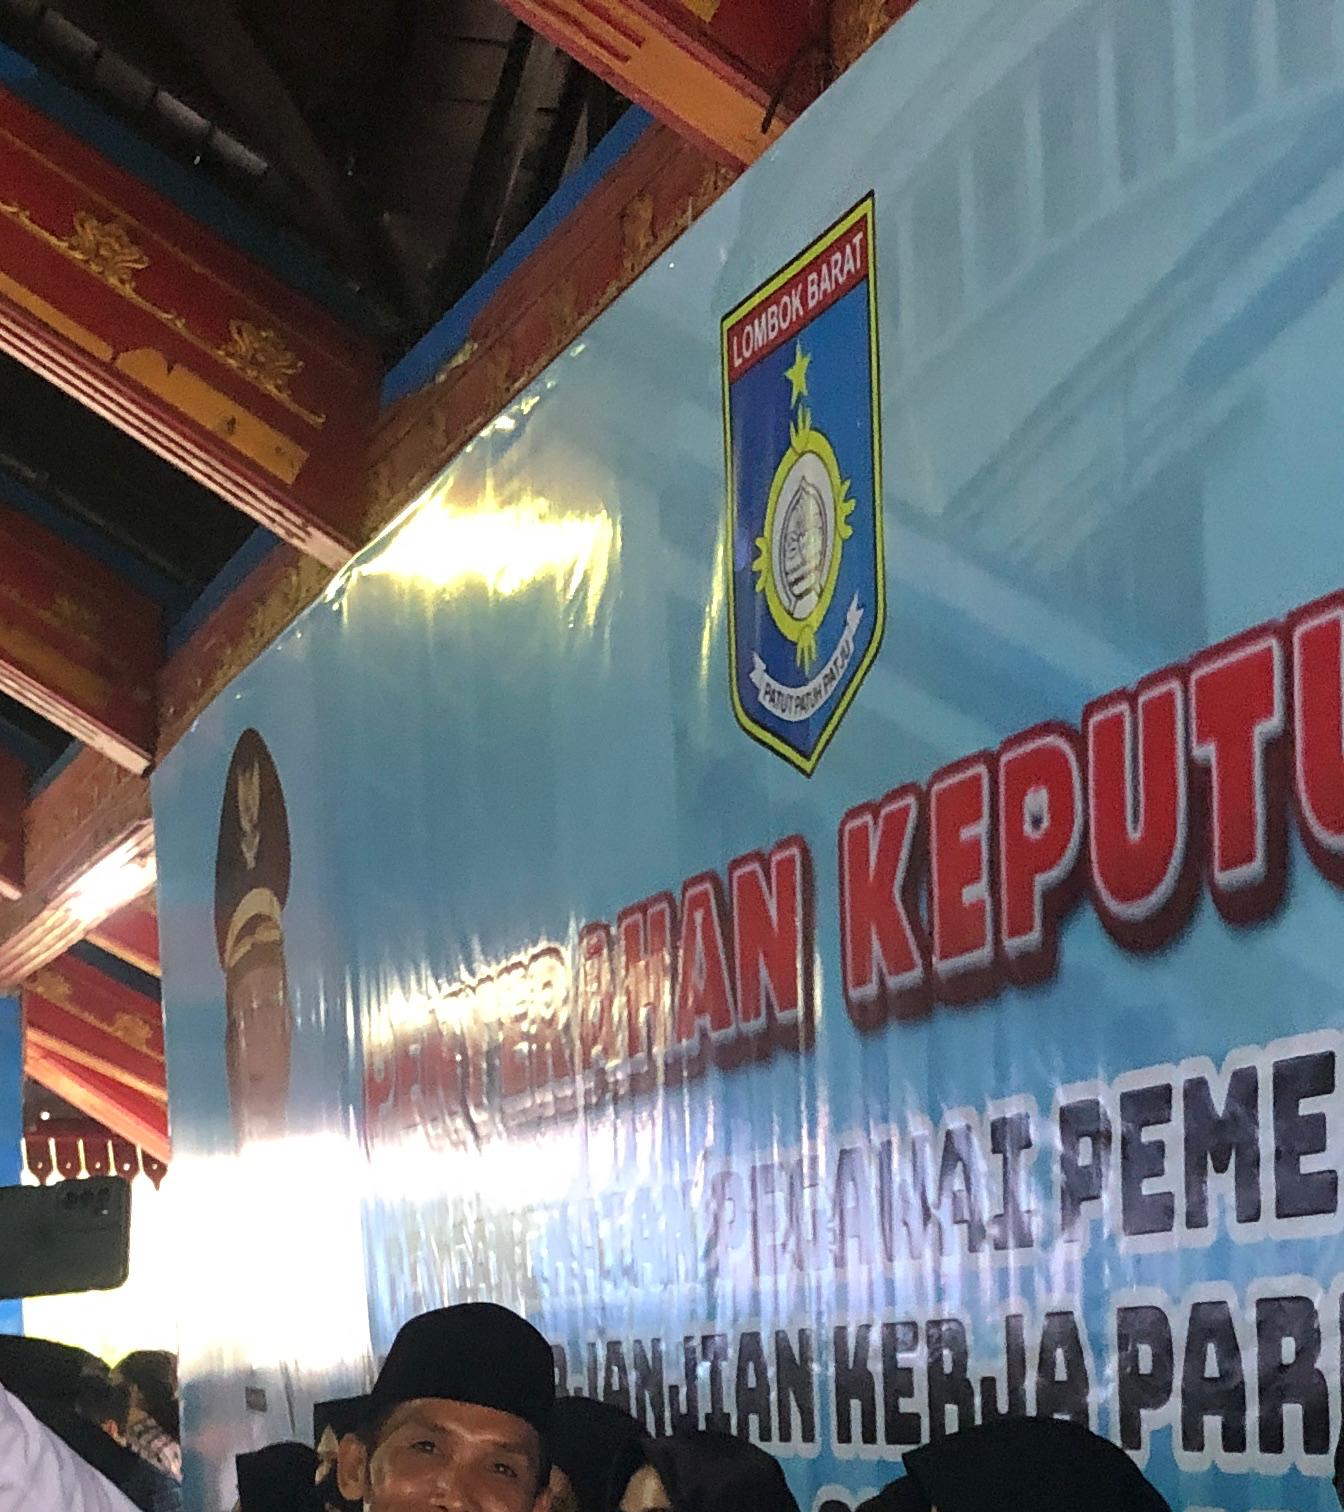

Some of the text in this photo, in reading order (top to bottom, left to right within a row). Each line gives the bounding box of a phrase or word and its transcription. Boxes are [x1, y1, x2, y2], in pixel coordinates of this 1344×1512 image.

[733, 231, 864, 368] LOMBOK BARAT
[551, 1327, 817, 1445] JANJIAN
[833, 1310, 1090, 1446] KERJA
